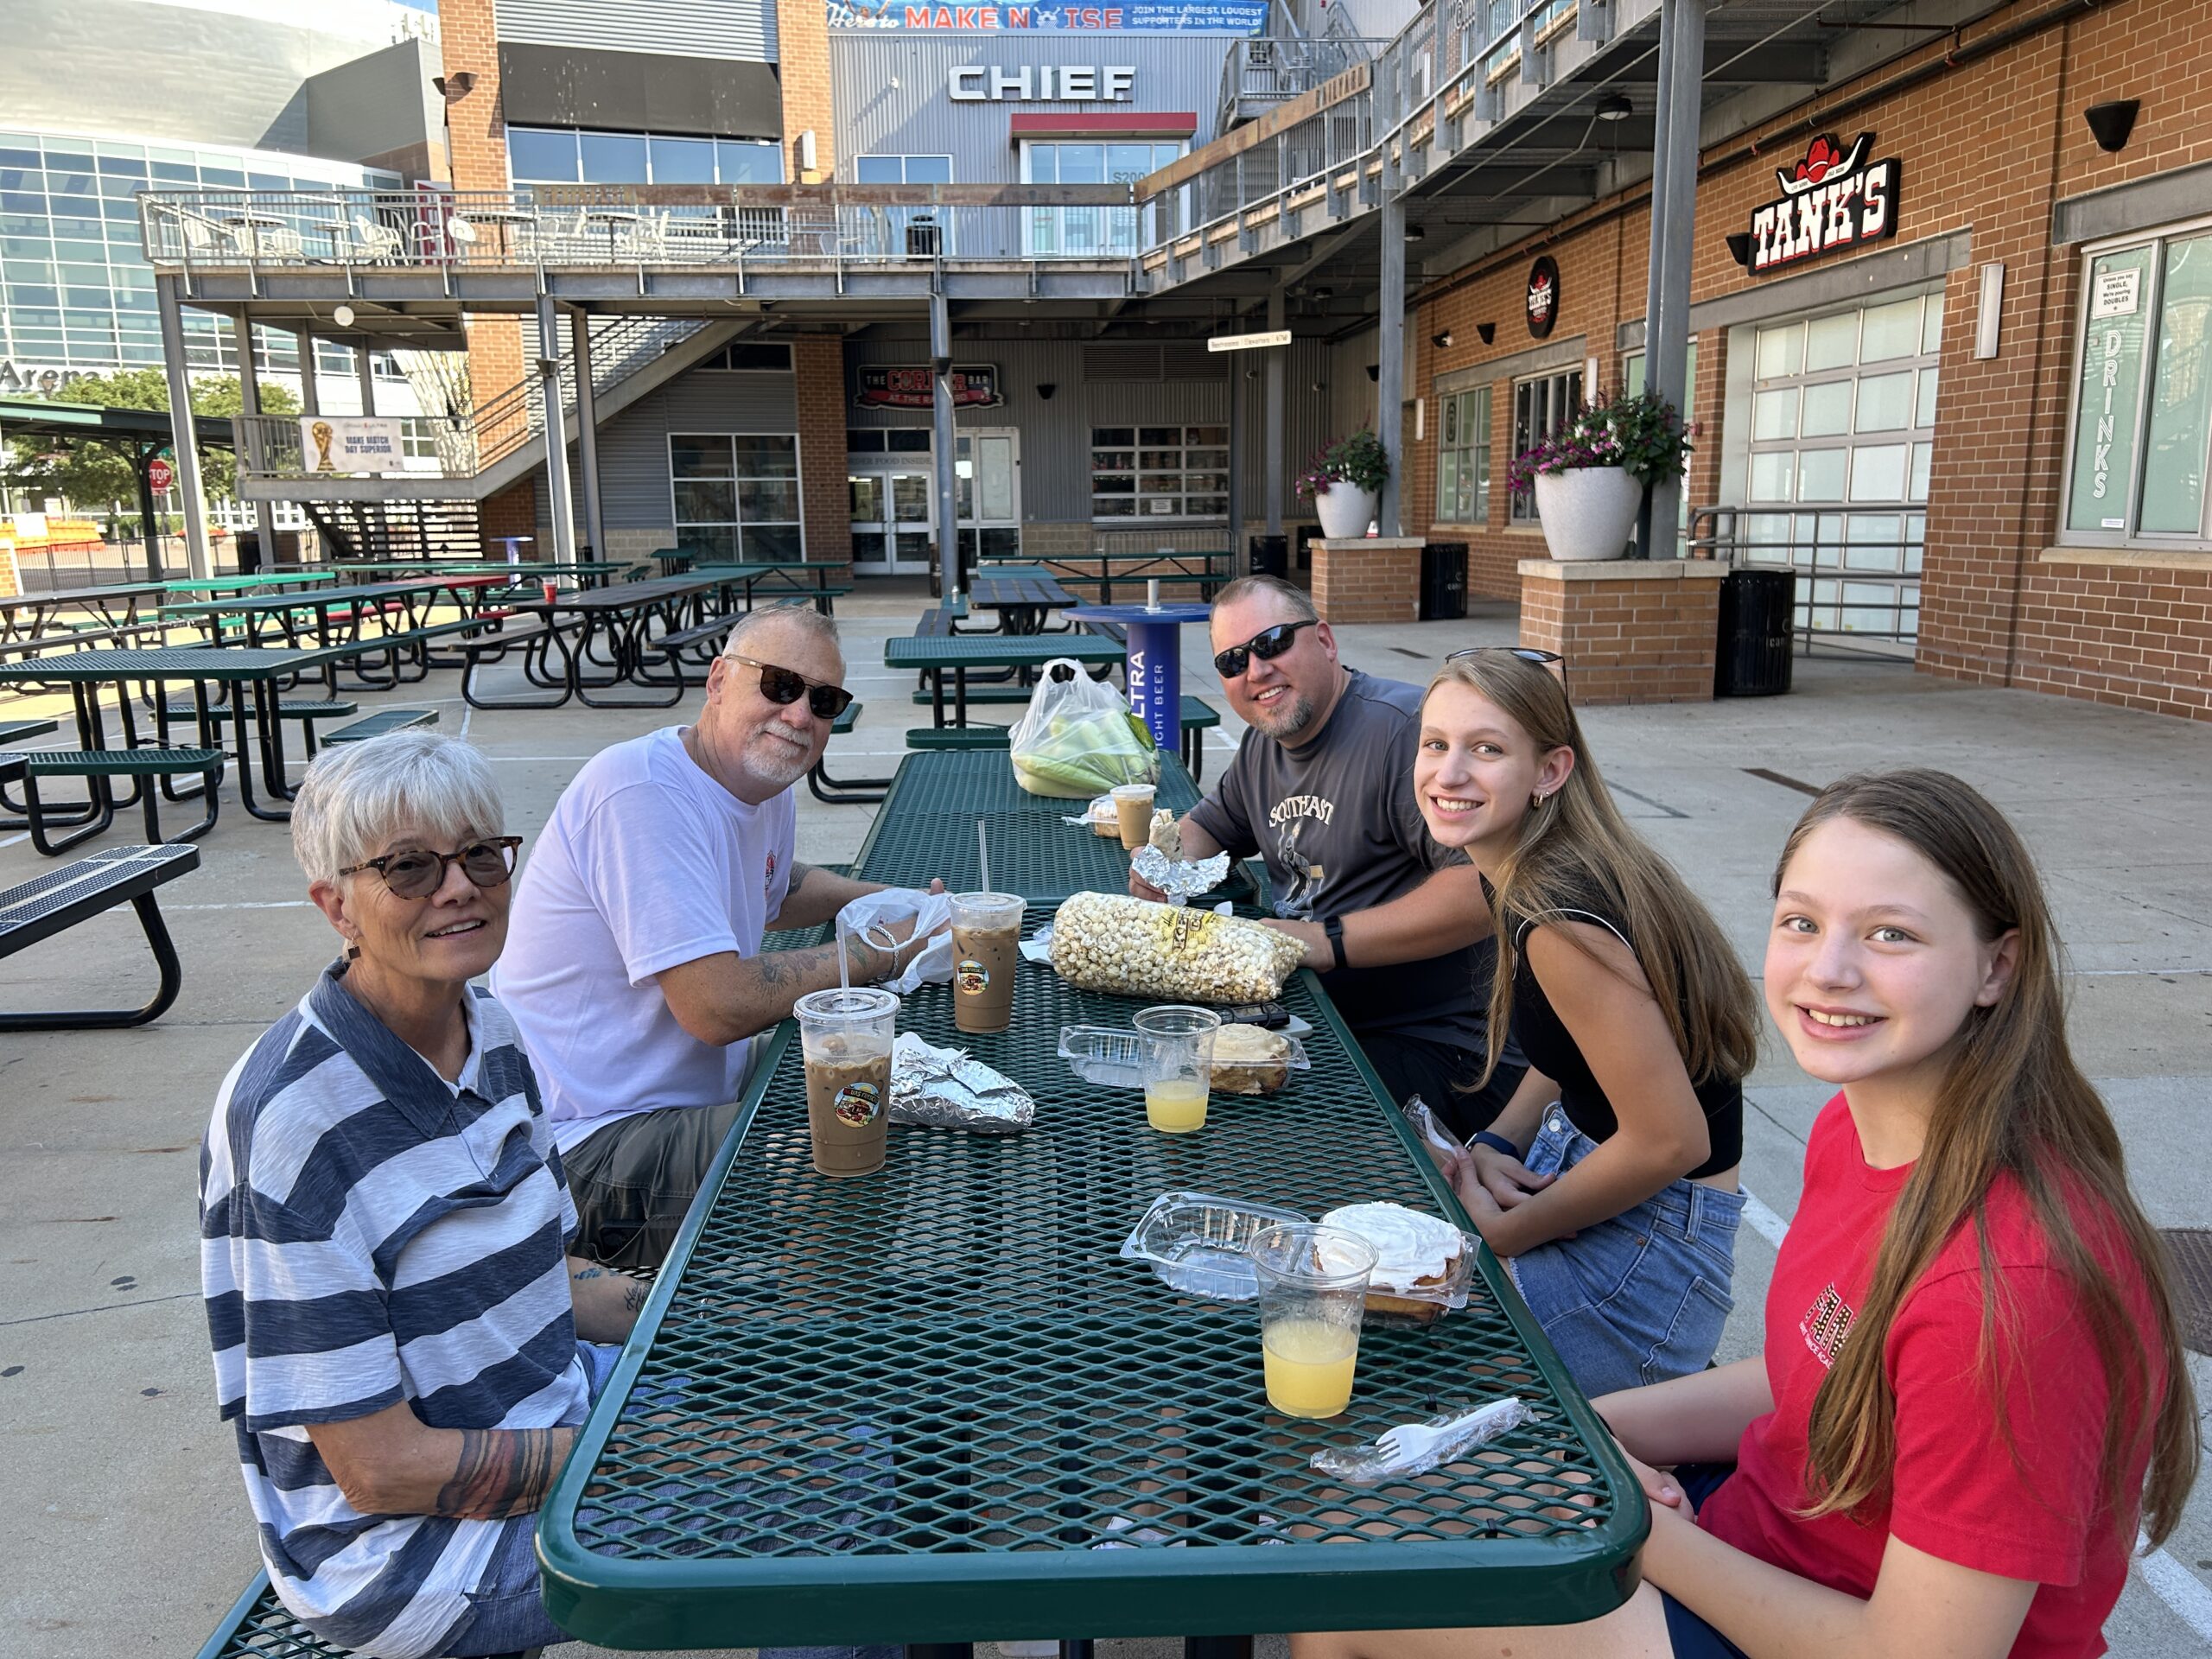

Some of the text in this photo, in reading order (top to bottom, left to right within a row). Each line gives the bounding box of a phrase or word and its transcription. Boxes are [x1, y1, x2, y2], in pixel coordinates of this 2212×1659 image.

[905, 6, 997, 29] MAKE
[1132, 6, 1156, 15] JOIN
[1157, 6, 1175, 15] THE
[1220, 7, 1263, 16] LOUDEST
[1132, 16, 1193, 25] SUPPORTERS
[1194, 16, 1205, 25] IN
[1206, 16, 1225, 25] THE
[948, 66, 1136, 100] CHIEF
[1753, 162, 1888, 270] TANK'S
[2103, 296, 2129, 305] DOUBLES
[867, 370, 988, 391] THE CORR BAR
[2093, 329, 2122, 499] DRINKS
[149, 468, 170, 480] TOP
[1130, 650, 1145, 719] LTRA
[1154, 664, 1164, 747] IGHT BEER
